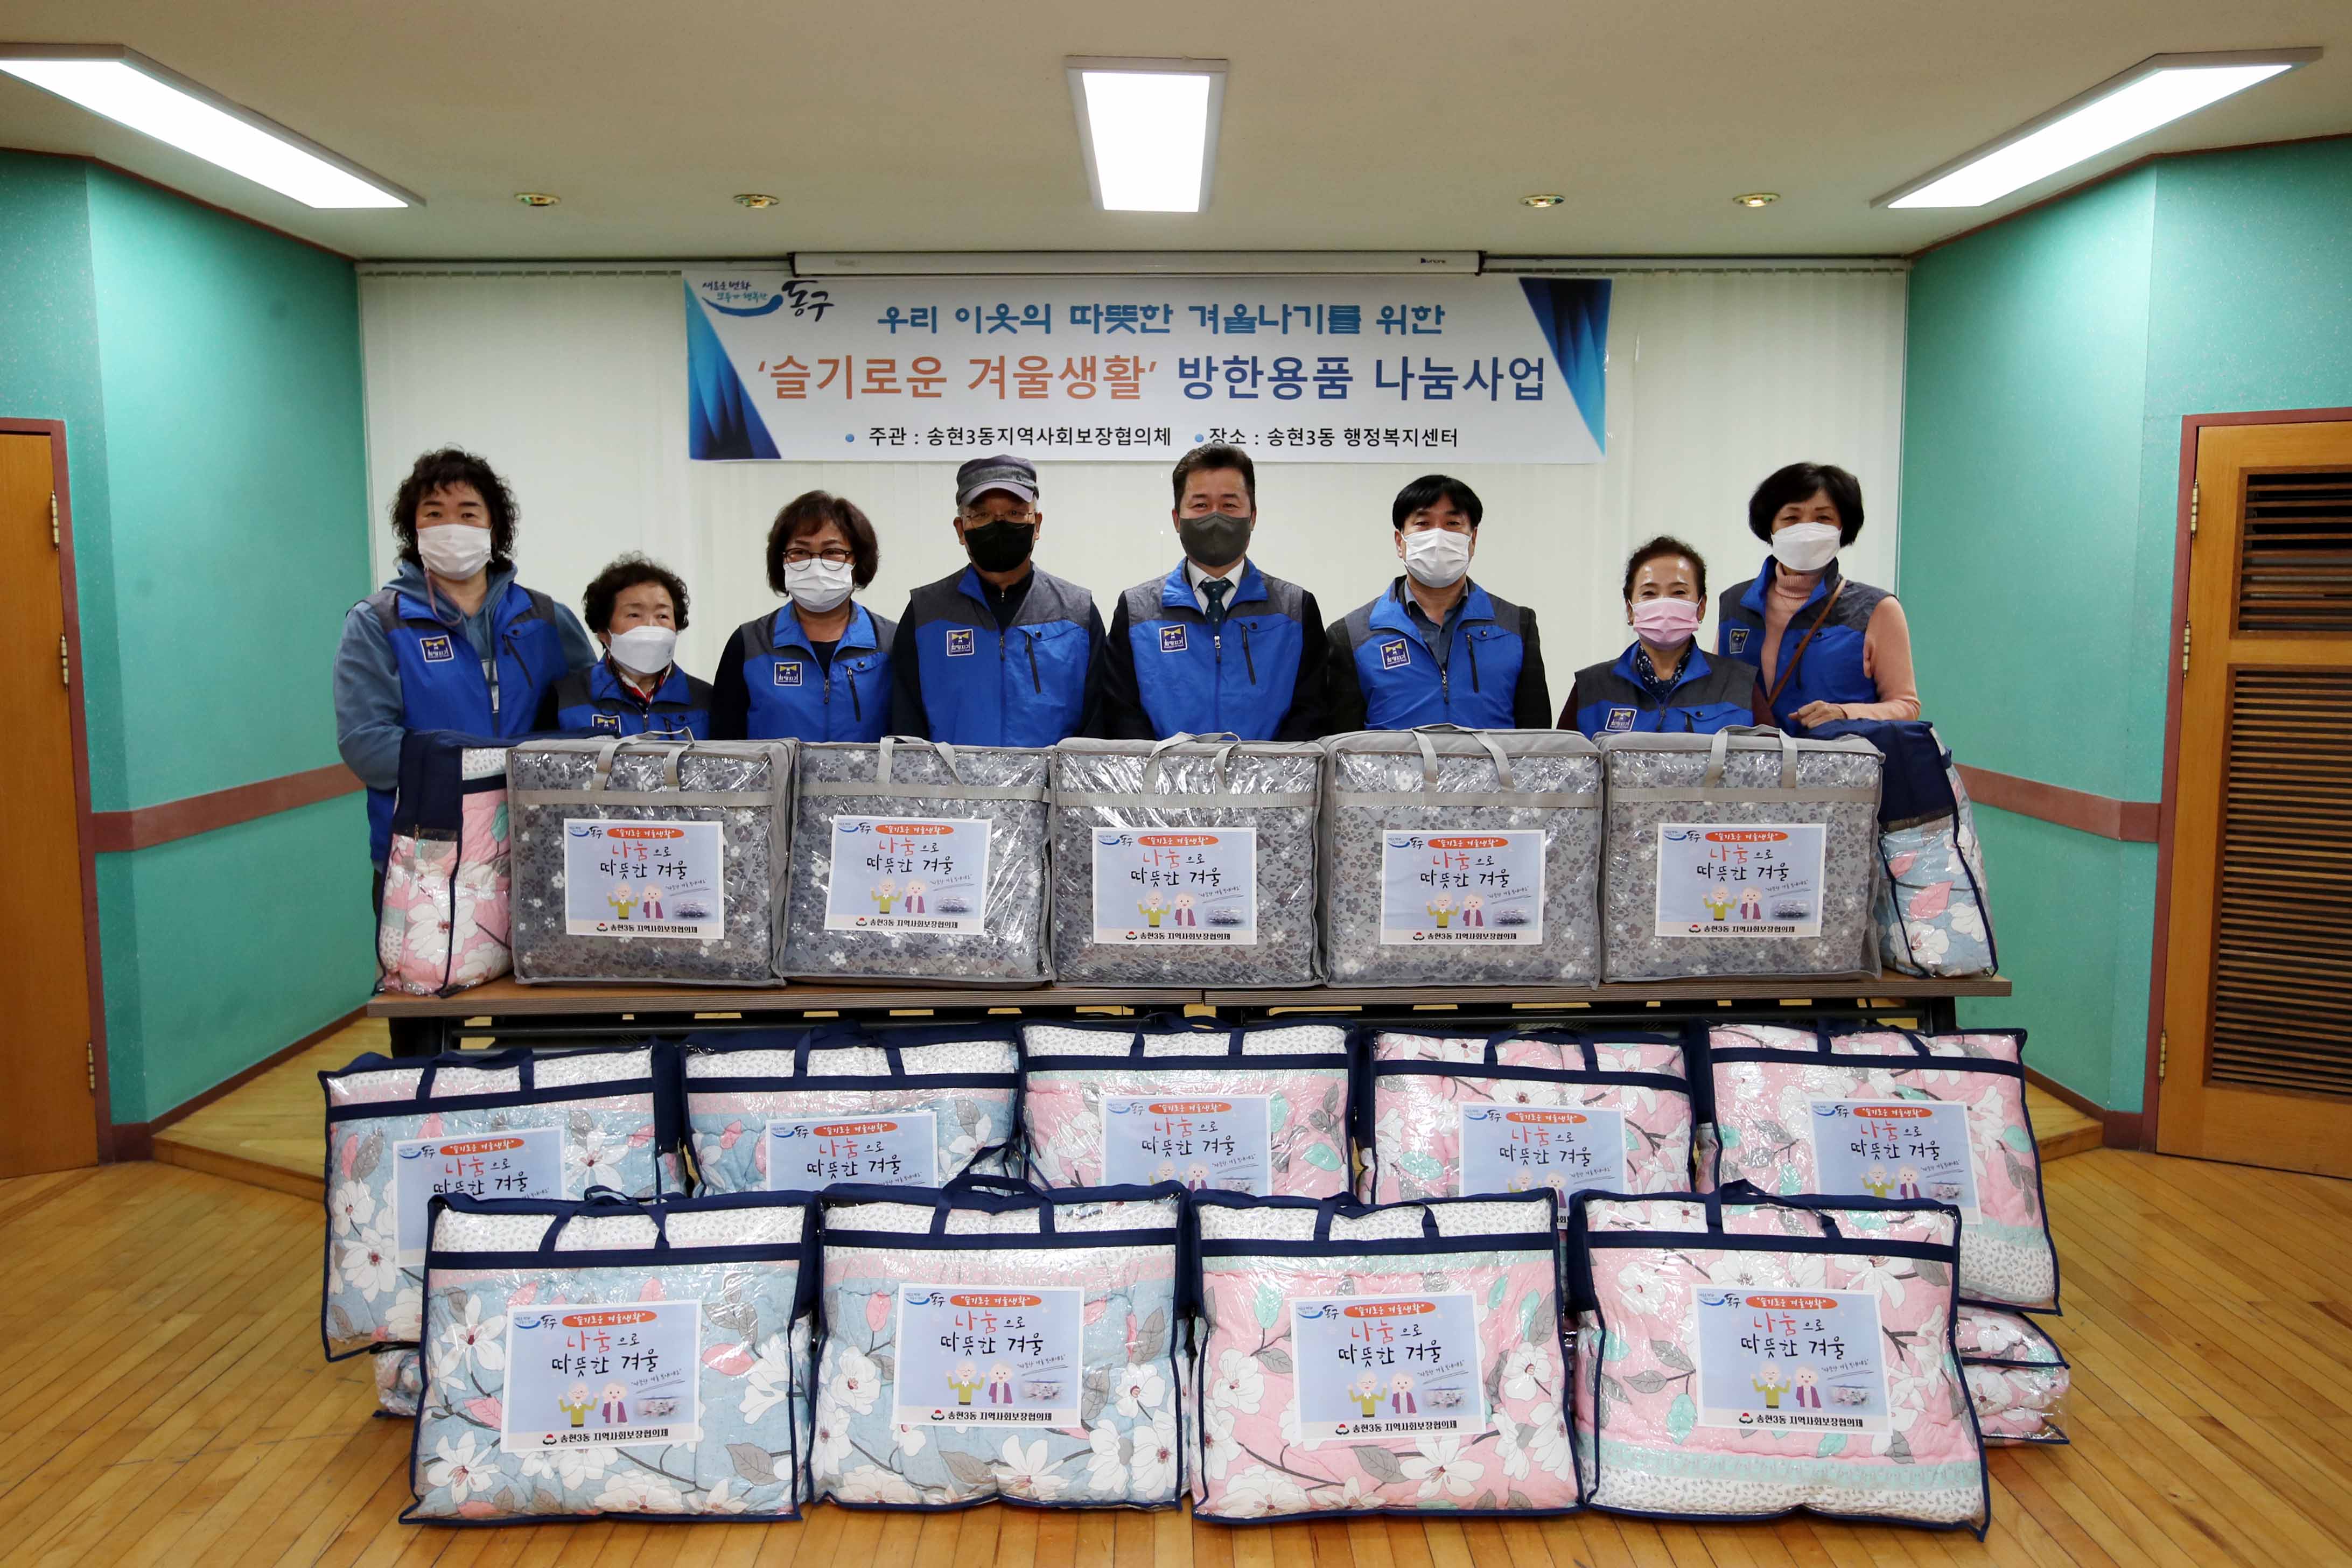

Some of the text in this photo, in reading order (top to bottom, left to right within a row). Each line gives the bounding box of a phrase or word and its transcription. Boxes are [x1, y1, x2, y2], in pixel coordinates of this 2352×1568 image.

[782, 281, 835, 322] 동구
[878, 303, 1445, 335] 우리 이웃의 따뜻한 겨울나기를 위한
[1179, 355, 1353, 400] 방한용품
[1376, 356, 1543, 401] 나눔사업
[870, 427, 907, 446] 주관
[927, 427, 1170, 446] 송현3동지역사회보장협의체
[1208, 428, 1246, 445] 장소
[1268, 428, 1335, 446] 송현3동
[1344, 428, 1457, 447] 행정복지센터
[601, 859, 688, 880] 따뜻한 겨울
[866, 854, 954, 876] 따뜻한 겨울
[1697, 862, 1789, 883] 따뜻한 겨울
[1131, 867, 1222, 888] 따뜻한 겨울
[1420, 869, 1510, 890] 따뜻한 겨울
[638, 925, 698, 934] 지역사회보장협의체
[897, 920, 958, 929] 지역사회보장협의체
[1142, 1135, 1236, 1158] 따뜻한 겨울
[1500, 1144, 1592, 1167] 따뜻한 겨울
[1851, 1139, 1941, 1161] 따뜻한 겨울
[807, 1159, 858, 1180] 따뜻한
[869, 1154, 902, 1175] 겨울
[495, 1171, 529, 1193] 겨울
[929, 1292, 946, 1308] 동구
[1725, 1293, 1741, 1308] 동구
[540, 1314, 557, 1330] 동구
[1323, 1304, 1340, 1320] 동구
[941, 1332, 1044, 1356] 따뜻한 겨울
[1338, 1340, 1442, 1368] 따뜻한 겨울
[1741, 1333, 1845, 1360] 따뜻한 겨울
[552, 1348, 659, 1378] 따뜻한 겨울
[948, 1411, 1052, 1421] 송현3동 지역사회보장협의체
[1354, 1420, 1457, 1433] 송현3동 지역사회보장협의체
[1758, 1415, 1863, 1427] 송현3동 지역사회보장협의체
[561, 1429, 668, 1443] 송현3동 지역사회보장협의체
